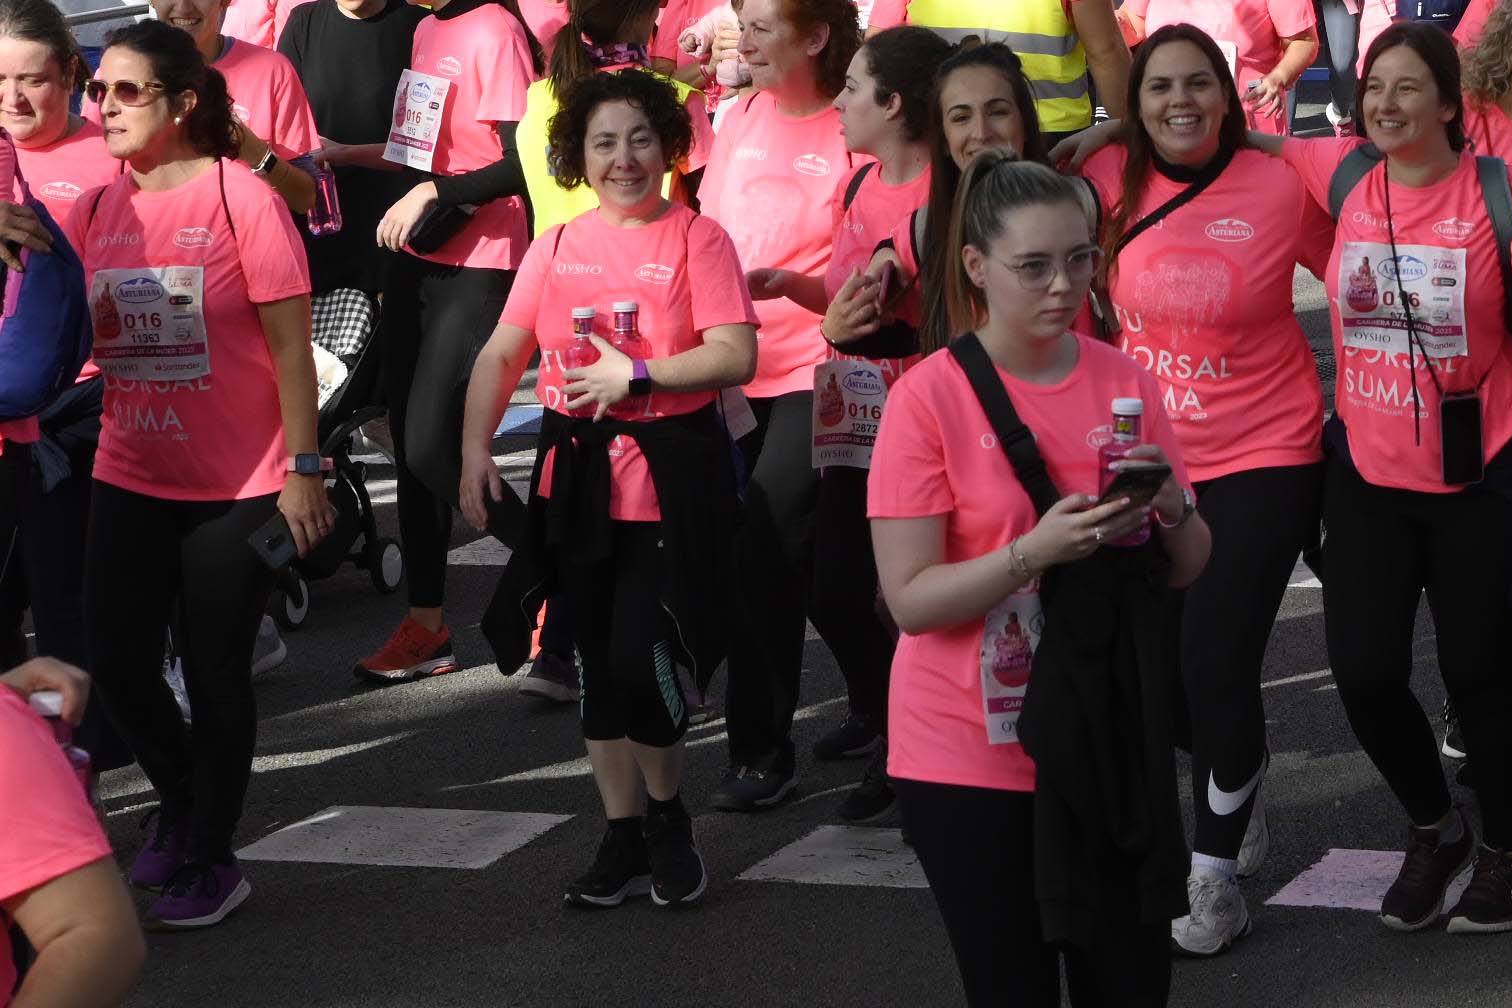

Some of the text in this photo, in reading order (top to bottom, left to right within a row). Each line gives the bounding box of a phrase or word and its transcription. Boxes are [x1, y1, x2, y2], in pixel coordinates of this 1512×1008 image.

[406, 109, 422, 124] 016
[1208, 225, 1251, 237] ASTURIANA
[556, 263, 602, 275] OYSHO
[1383, 292, 1421, 308] 06
[124, 313, 162, 329] 016
[131, 334, 160, 343] 11363
[1354, 332, 1391, 344] OYSHO
[1122, 336, 1233, 380] ORSAL
[1345, 368, 1425, 408] SUMA
[848, 403, 882, 419] 016
